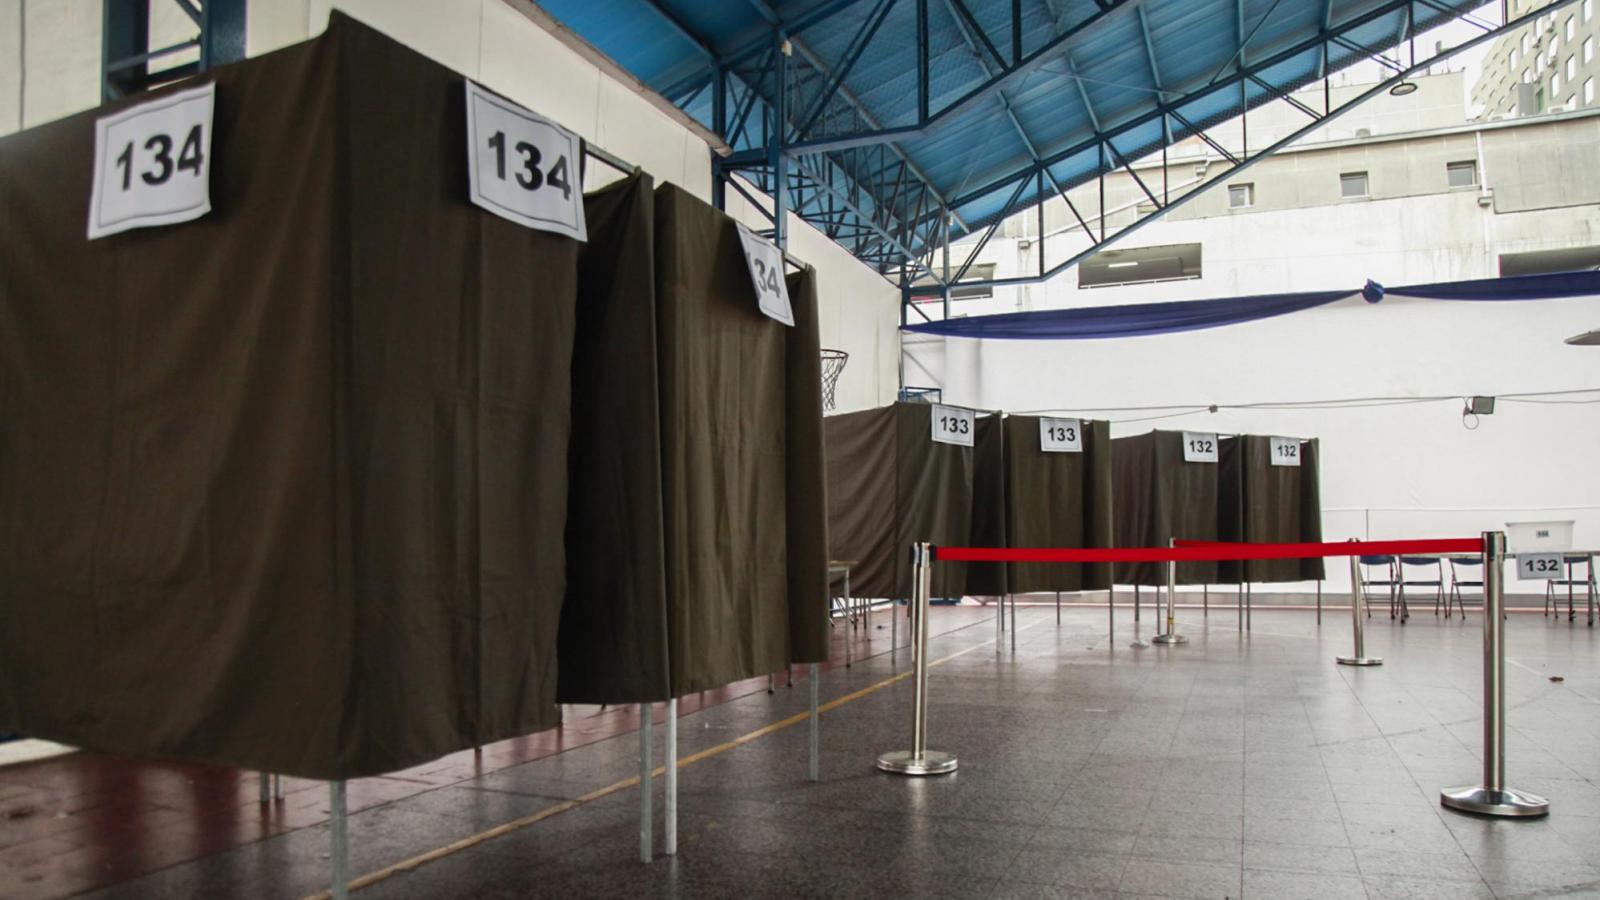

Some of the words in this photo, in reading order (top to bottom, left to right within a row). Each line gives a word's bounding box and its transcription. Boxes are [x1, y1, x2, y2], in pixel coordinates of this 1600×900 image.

[116, 124, 204, 191] 134
[488, 130, 572, 201] 134
[940, 416, 969, 434] 133
[1047, 427, 1076, 442] 133
[1189, 440, 1213, 453] 132
[1277, 445, 1297, 457] 132
[1525, 559, 1559, 572] 132
